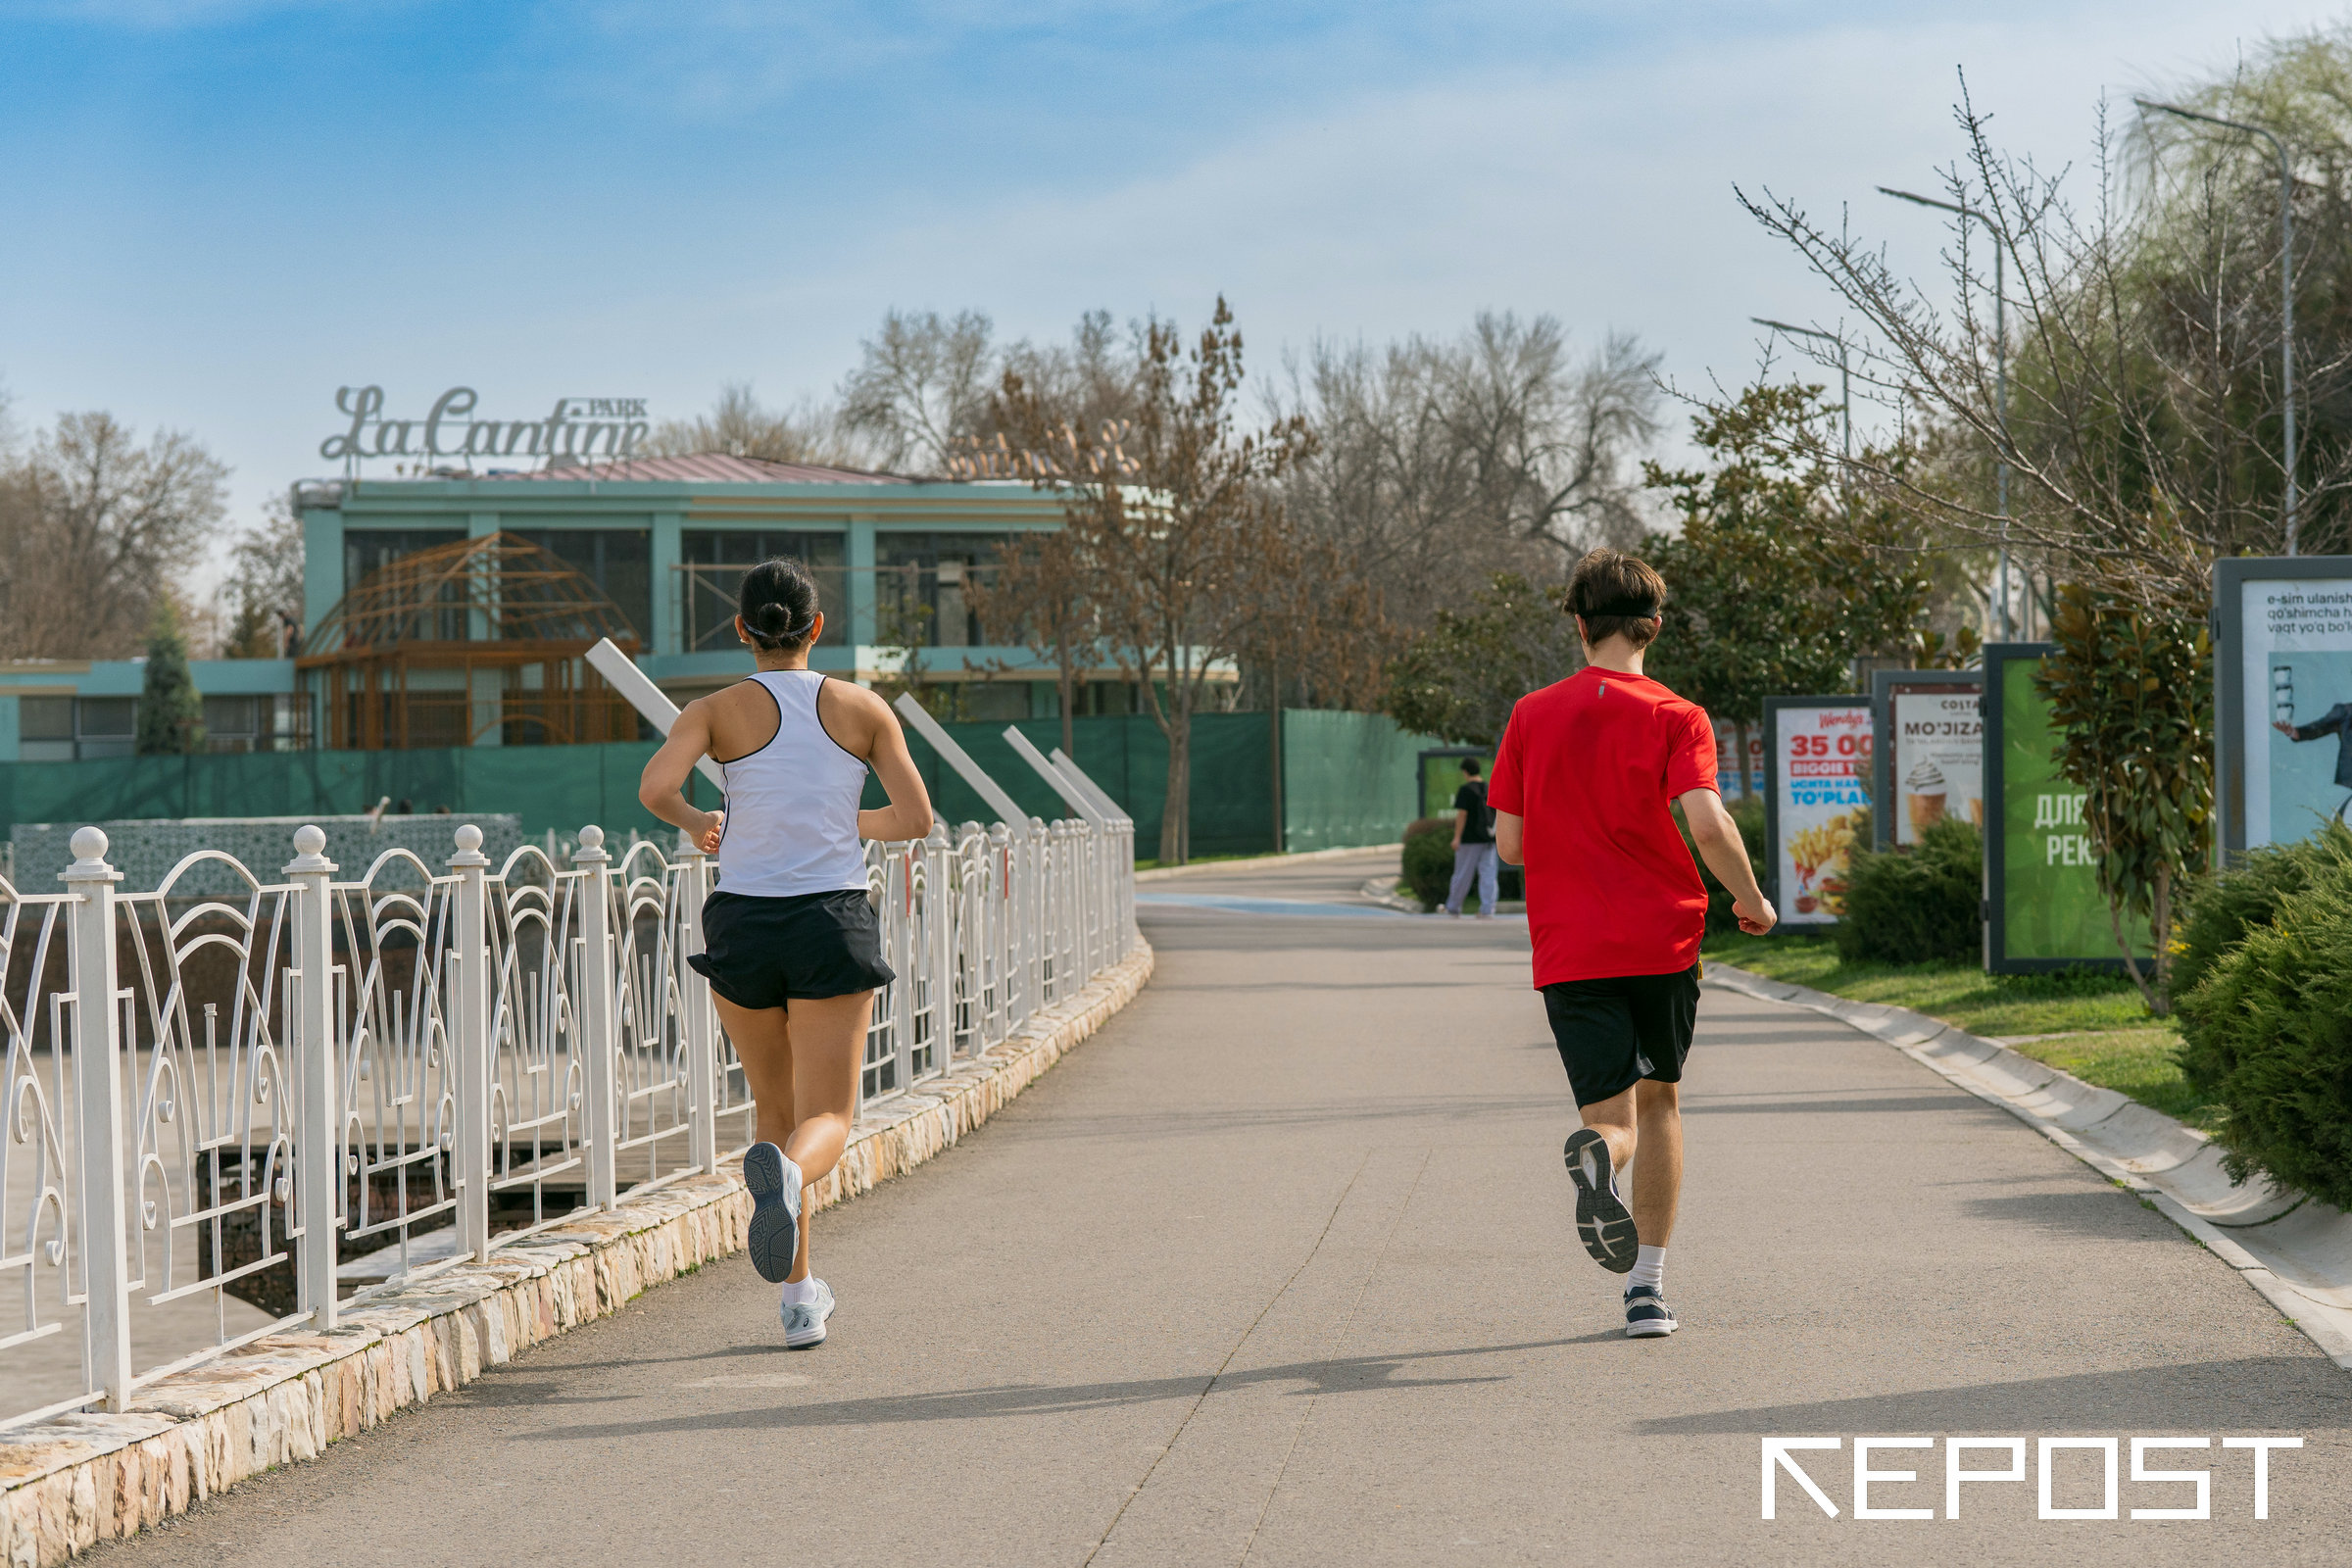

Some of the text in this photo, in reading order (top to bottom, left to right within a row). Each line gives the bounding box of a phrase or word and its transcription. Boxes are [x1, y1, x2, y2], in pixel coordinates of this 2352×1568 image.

[589, 398, 648, 416] PARK
[319, 384, 650, 460] La Cantine
[2268, 592, 2304, 605] e-sim
[2268, 608, 2339, 620] qo'shimcha
[2268, 620, 2352, 634] vaqt yo'q bo'l
[1790, 734, 1829, 757] 35
[2046, 834, 2098, 866] РЕК
